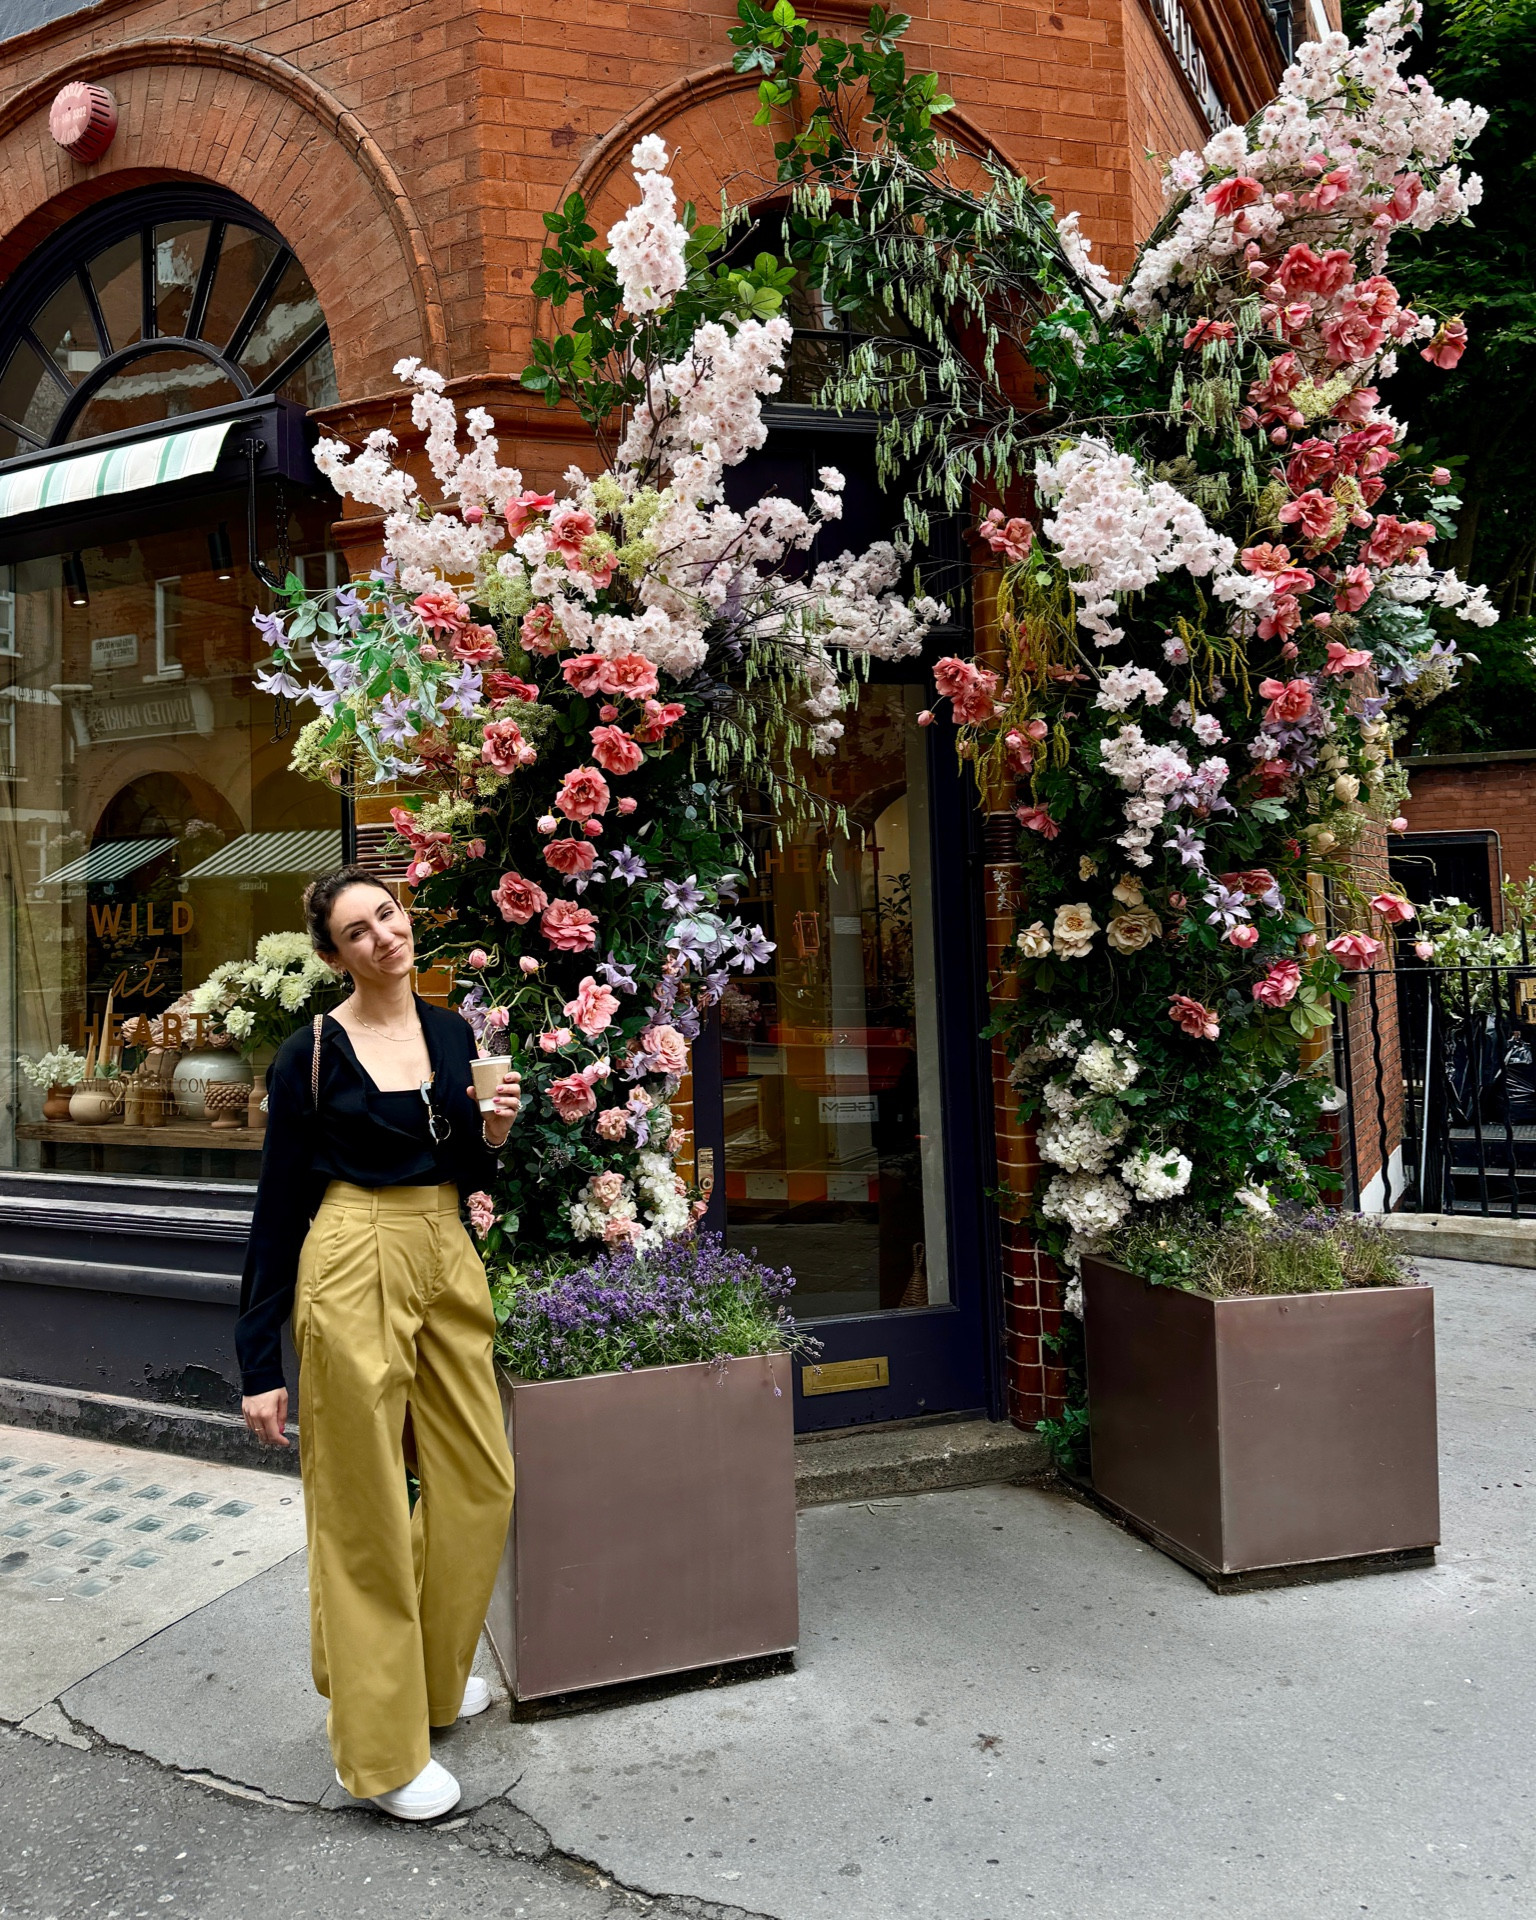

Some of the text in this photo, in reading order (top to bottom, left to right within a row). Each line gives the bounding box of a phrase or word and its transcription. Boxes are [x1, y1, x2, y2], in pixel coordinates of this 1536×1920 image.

[91, 901, 194, 938] WILD
[112, 946, 169, 998] at
[79, 1013, 210, 1047] HEART
